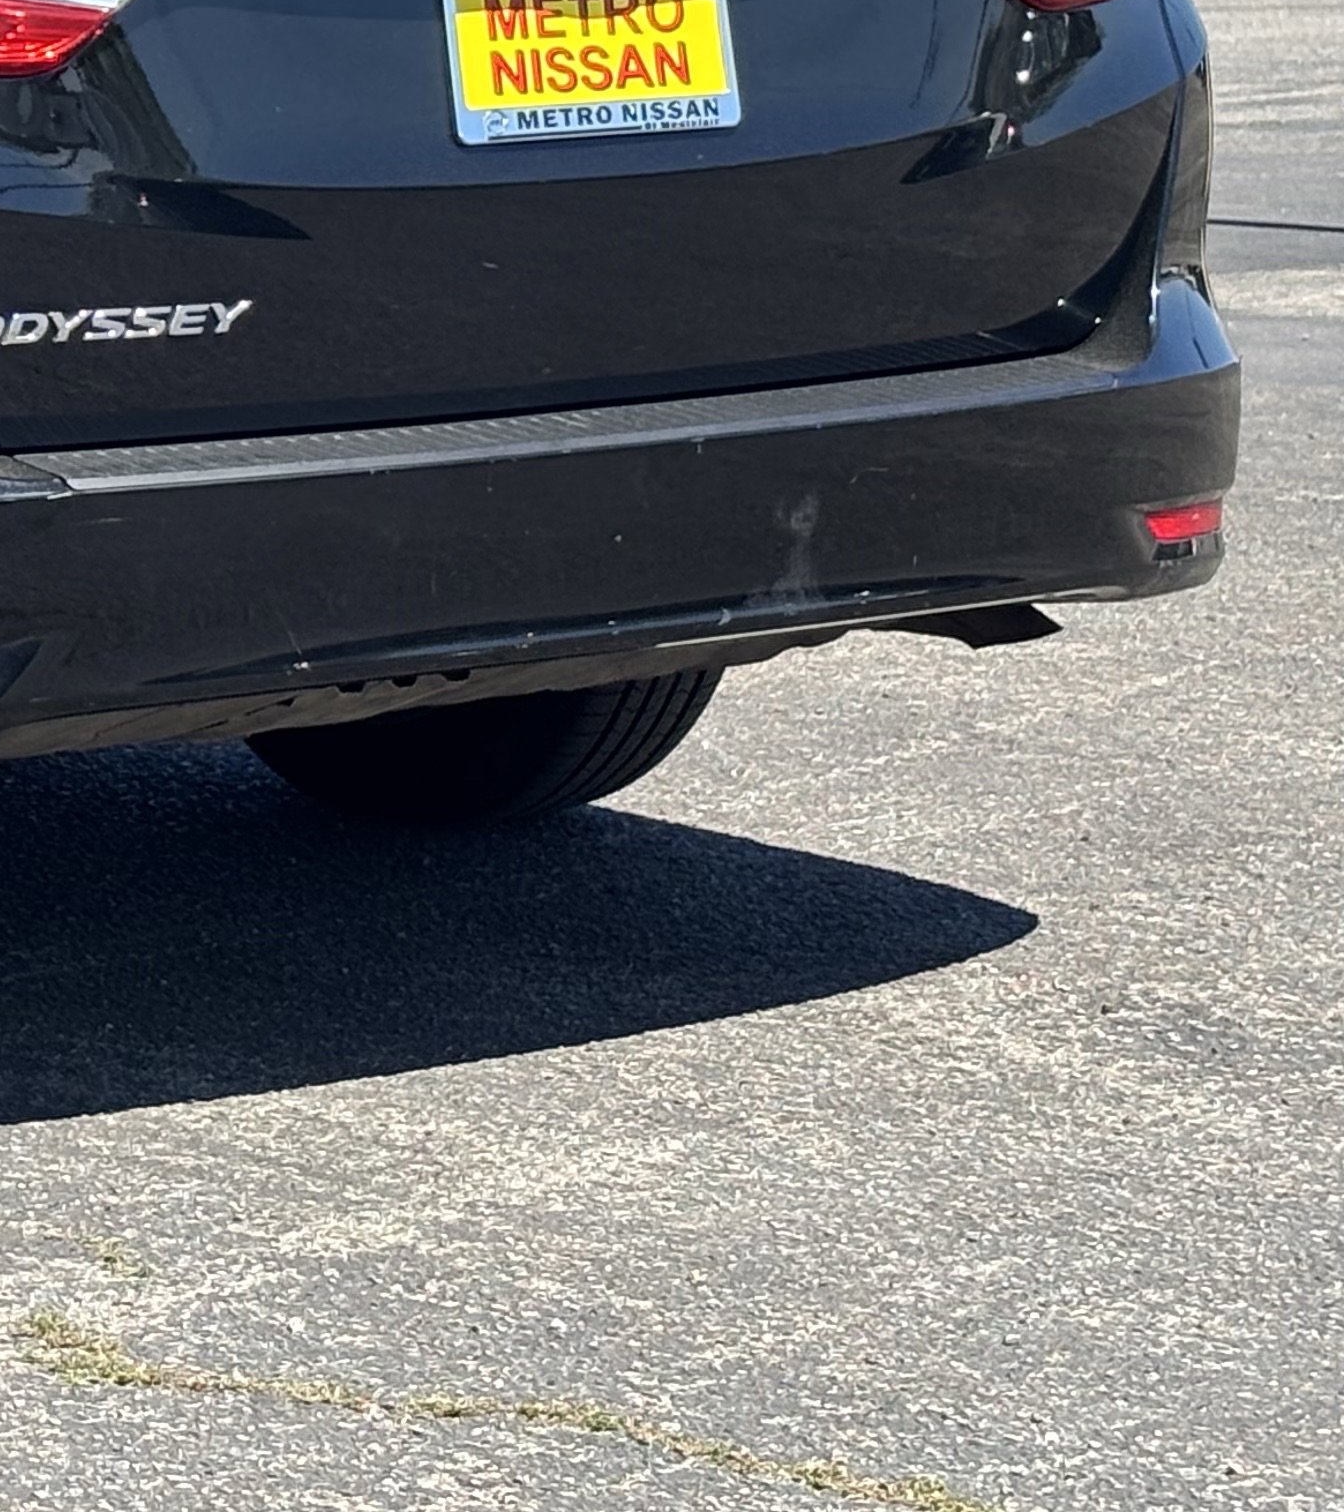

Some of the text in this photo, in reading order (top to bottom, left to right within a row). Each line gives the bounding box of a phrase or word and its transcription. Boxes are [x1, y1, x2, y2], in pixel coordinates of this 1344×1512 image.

[489, 40, 692, 96] NISSAN
[517, 105, 613, 131] METRO
[621, 98, 720, 122] NISSAN
